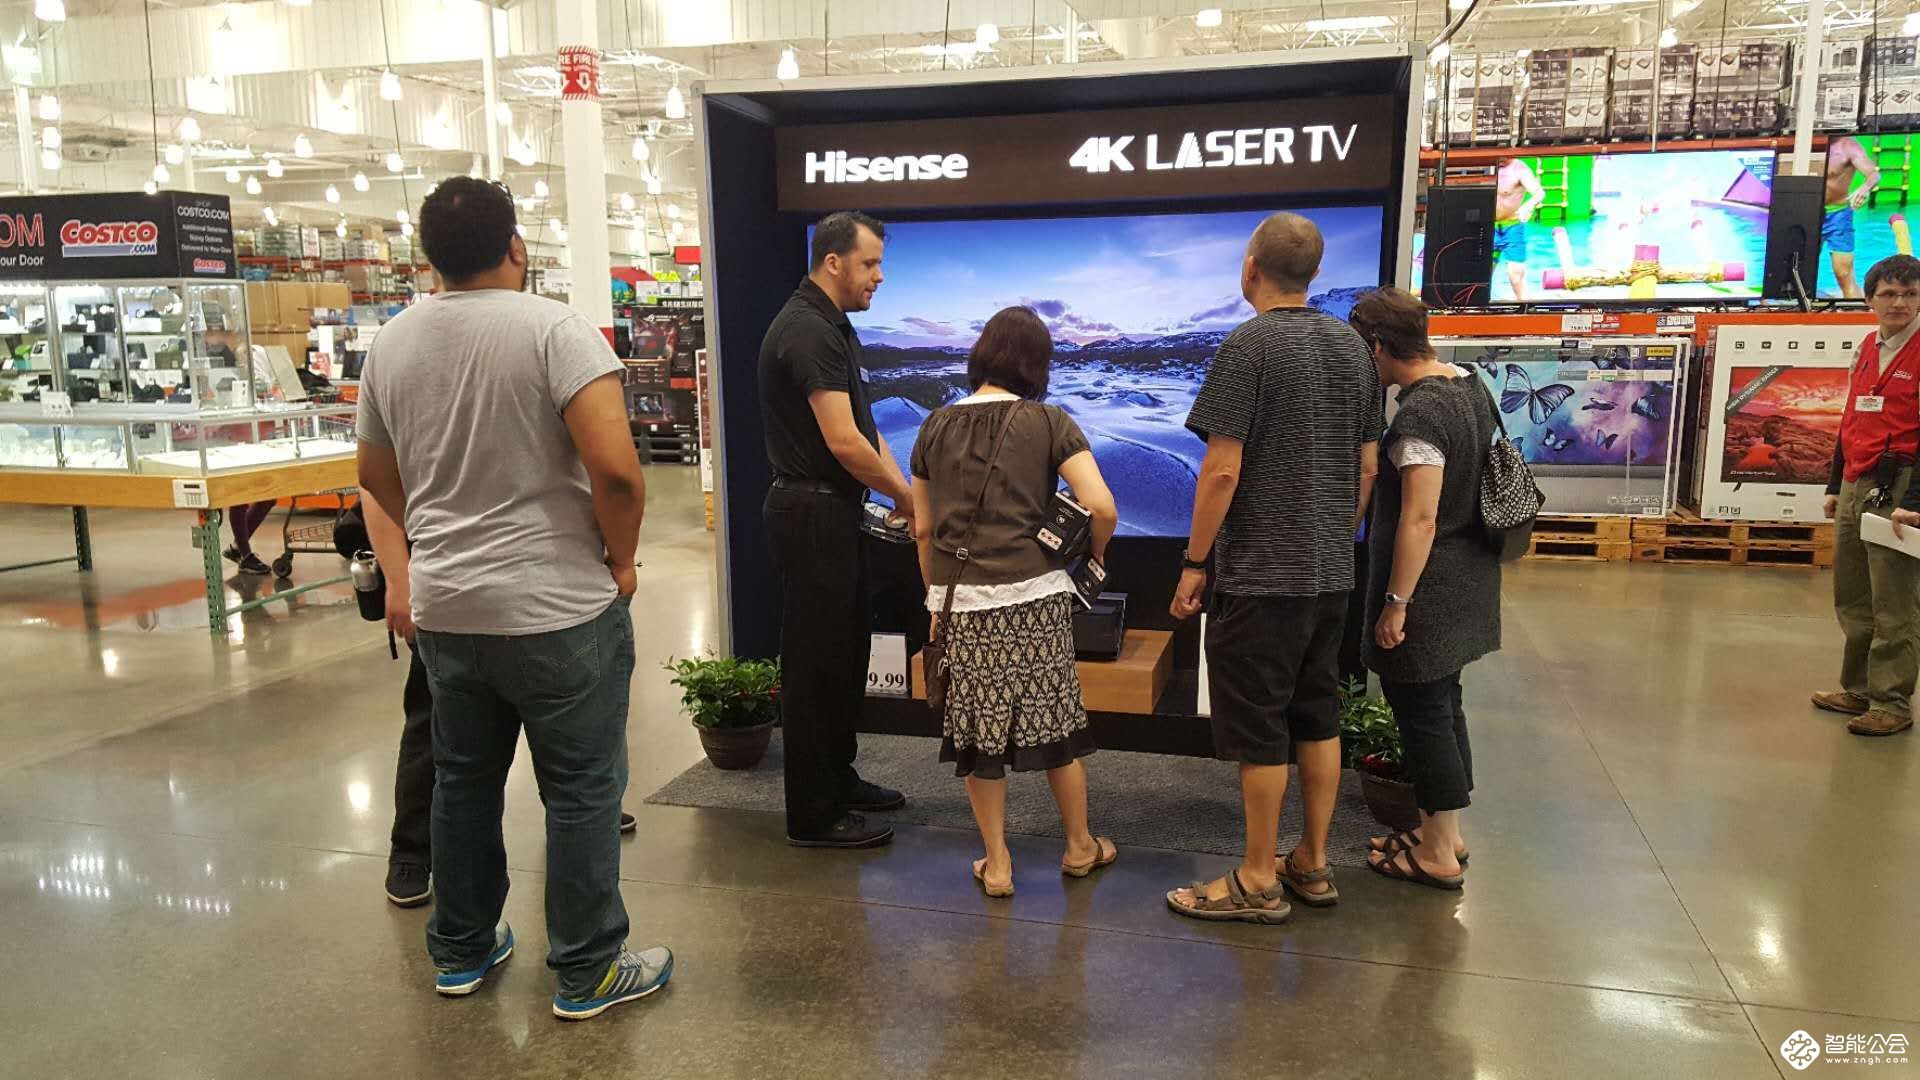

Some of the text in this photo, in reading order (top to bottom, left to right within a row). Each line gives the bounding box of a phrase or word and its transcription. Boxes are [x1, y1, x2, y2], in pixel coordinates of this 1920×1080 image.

[1069, 123, 1358, 173] 4K LASER TV
[805, 150, 968, 184] Hisense
[177, 206, 230, 220] COSTCO.COM
[19, 254, 45, 267] Door
[1603, 347, 1617, 359] 75
[1761, 367, 1779, 383] RANGE
